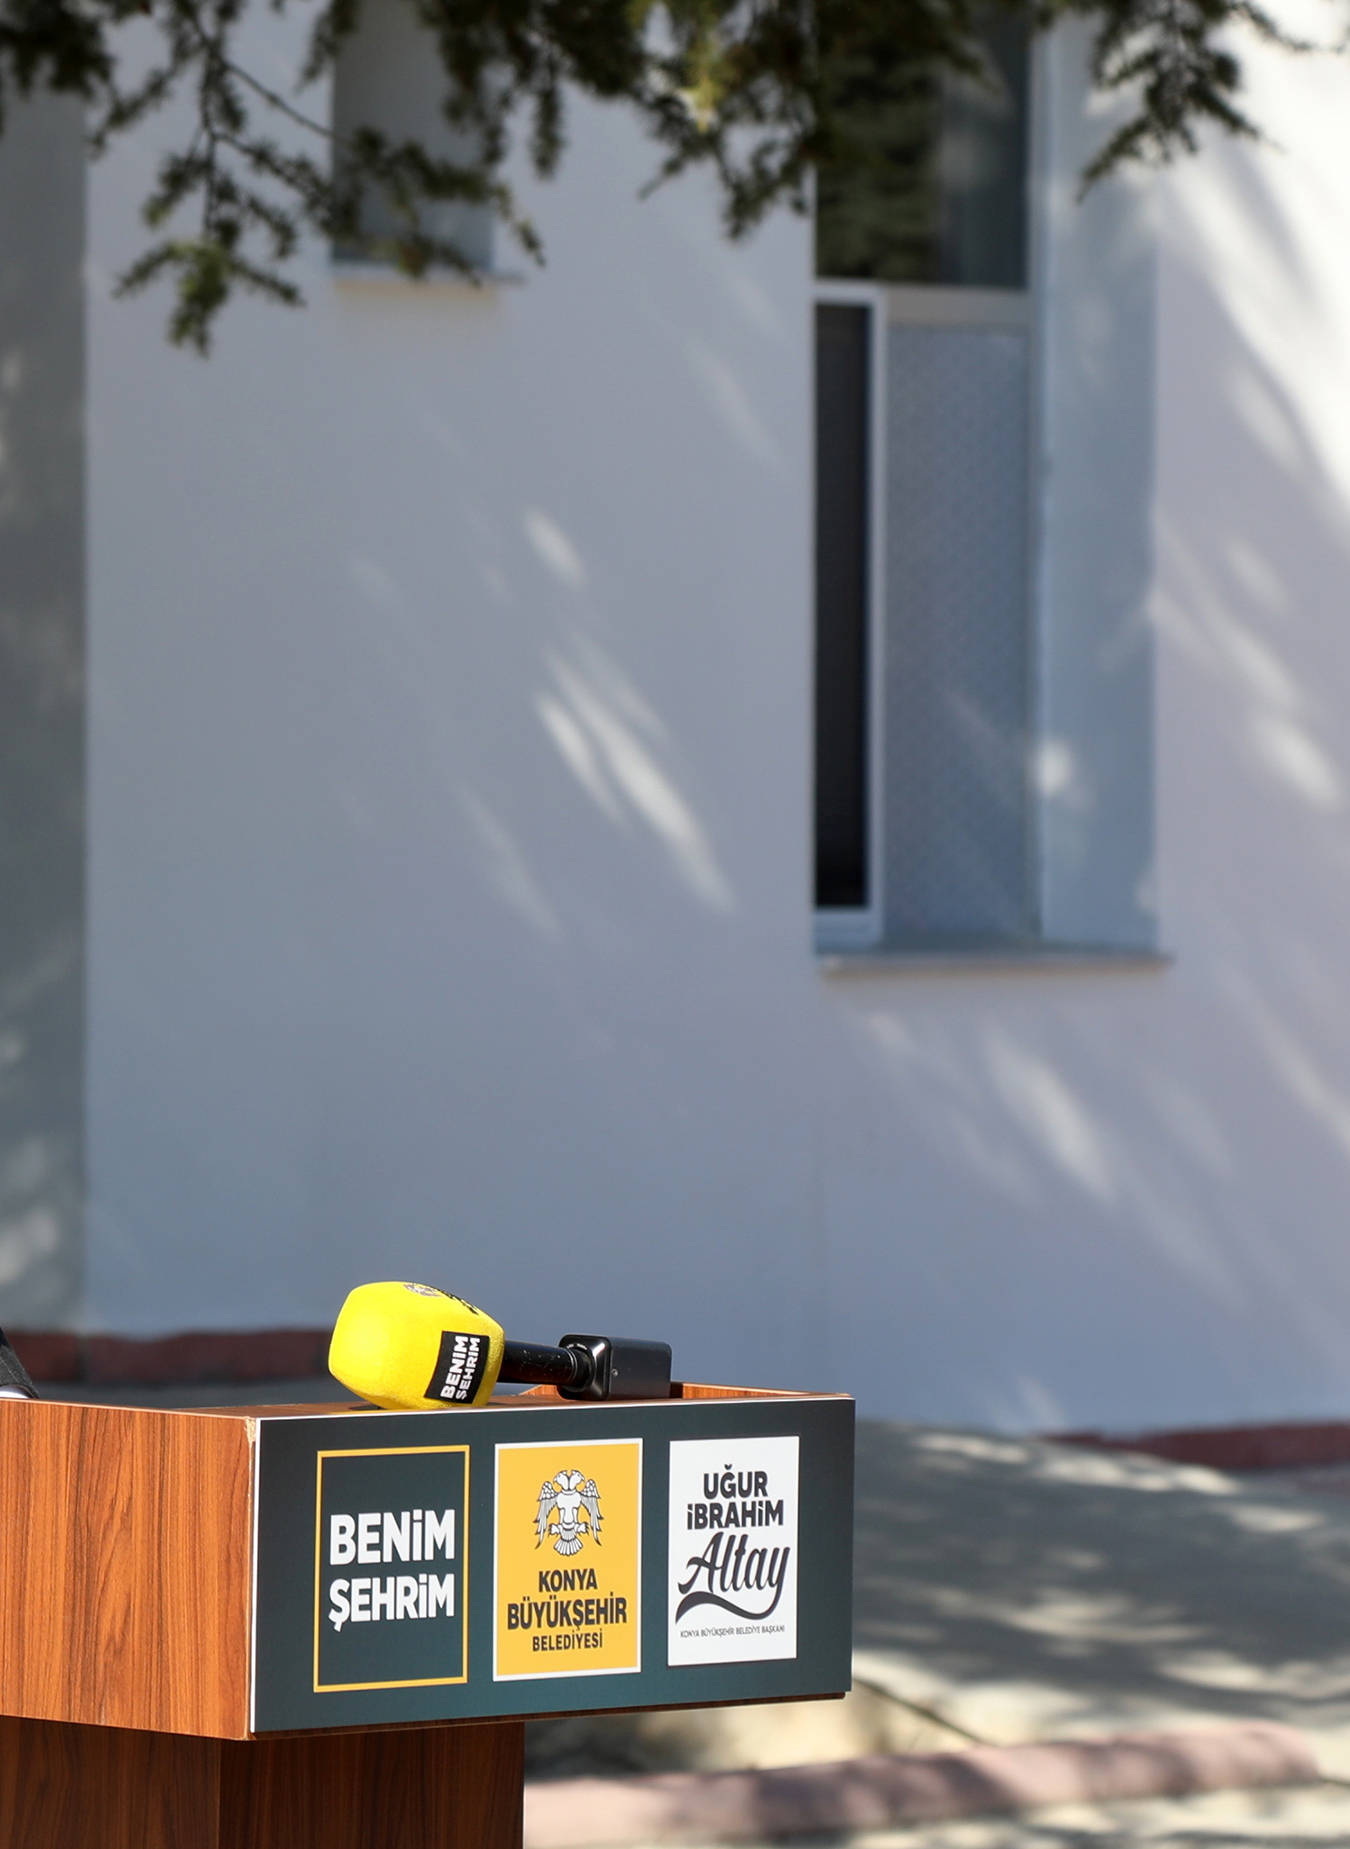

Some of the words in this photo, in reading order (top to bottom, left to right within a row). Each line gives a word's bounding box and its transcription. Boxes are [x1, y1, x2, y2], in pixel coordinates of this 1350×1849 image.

[703, 1463, 768, 1500] UĞUR
[538, 1568, 598, 1593] KONYA
[675, 1531, 791, 1625] Altay
[507, 1591, 628, 1631] BÜYÜKŞEHİR
[532, 1628, 603, 1652] BELEDİYESİ
[680, 1629, 700, 1638] KONYA
